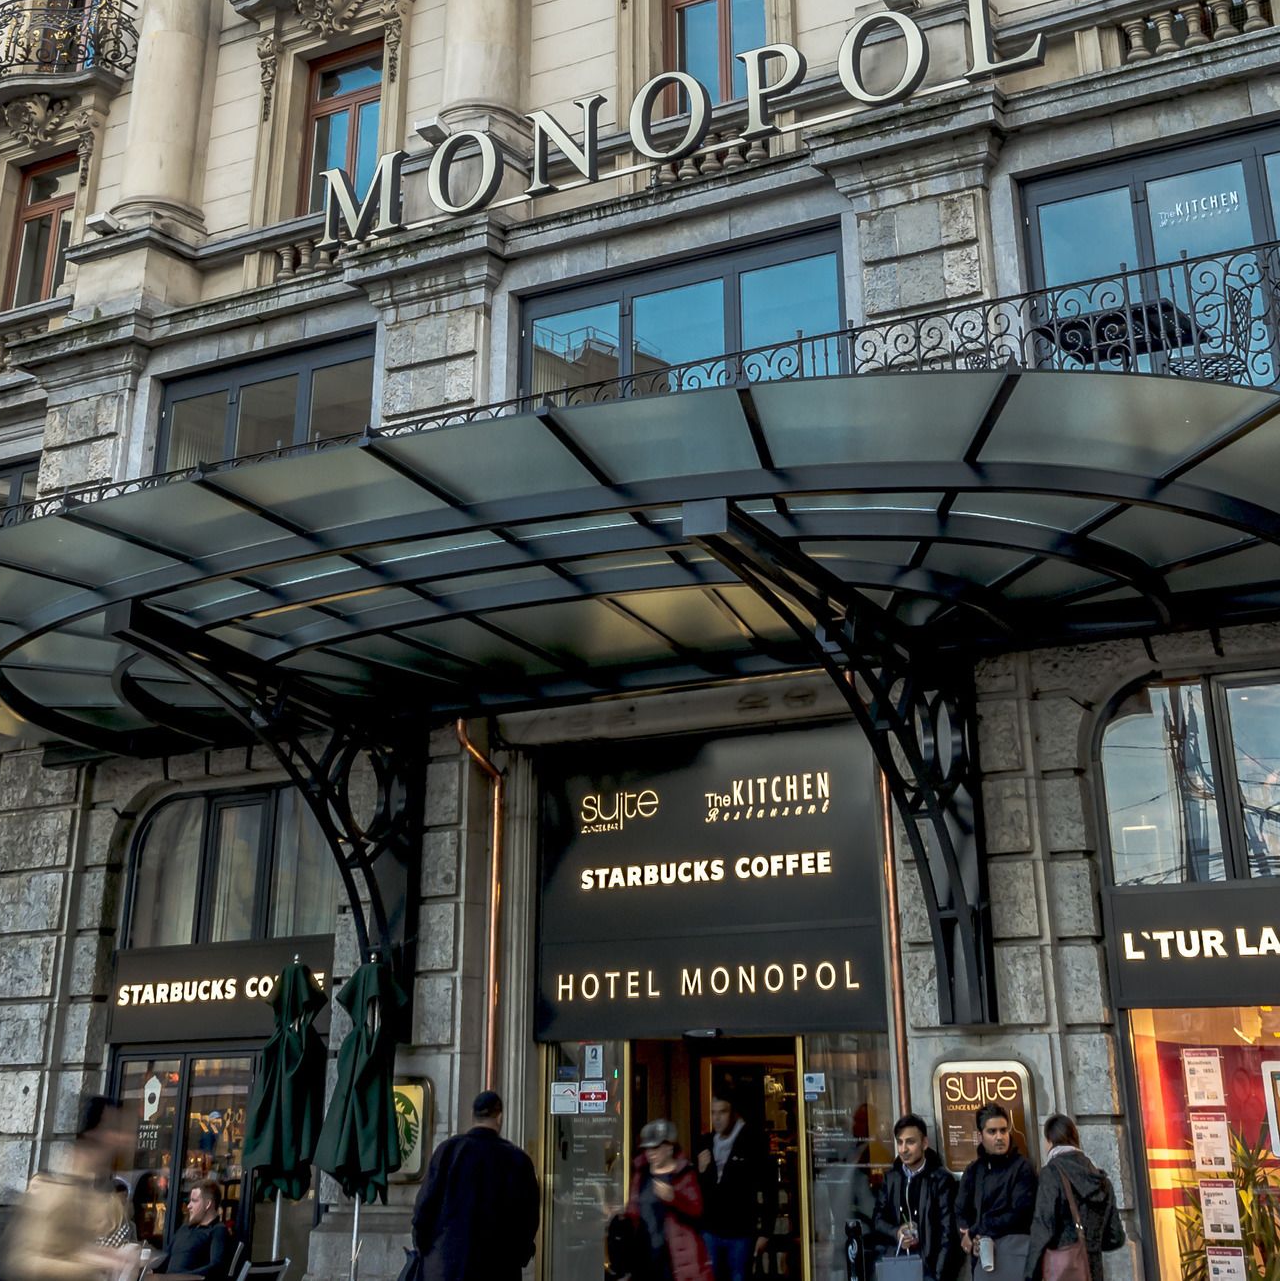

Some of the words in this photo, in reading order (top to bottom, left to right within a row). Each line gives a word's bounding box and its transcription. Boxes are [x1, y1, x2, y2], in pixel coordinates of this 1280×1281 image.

[1175, 190, 1238, 216] KITCHEN
[705, 793, 731, 808] The
[732, 771, 830, 806] KITCHEN
[581, 860, 724, 890] STARBUCKS
[735, 852, 831, 879] COFFEE
[118, 978, 237, 1006] STARBUCKS
[558, 970, 660, 1001] HOTEL
[681, 961, 860, 996] MONOPOL
